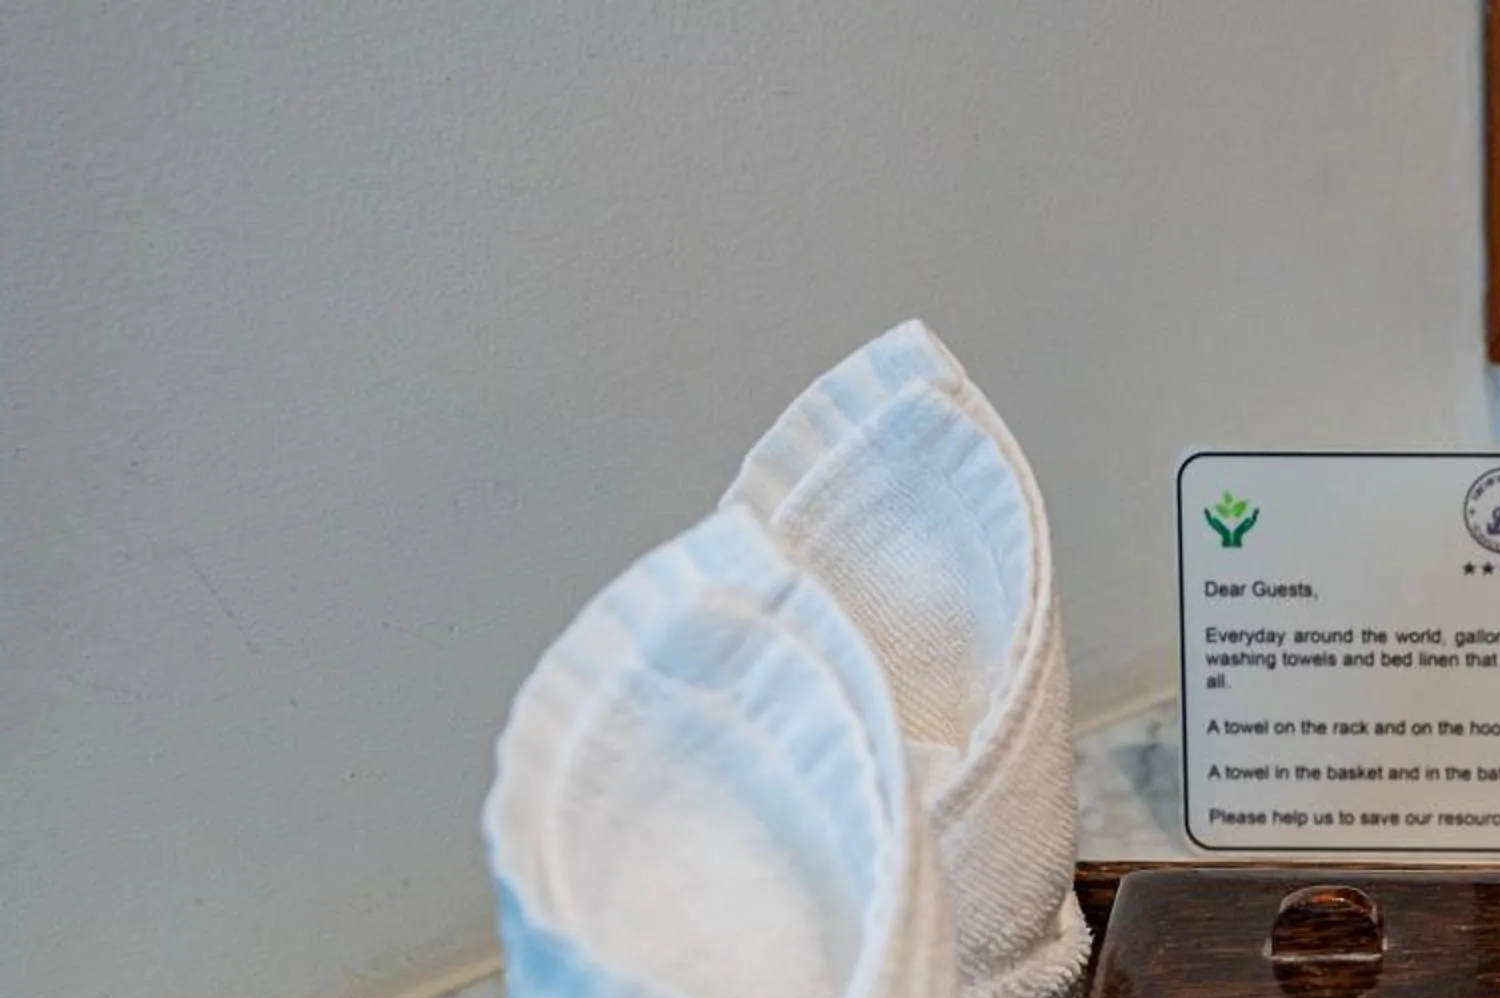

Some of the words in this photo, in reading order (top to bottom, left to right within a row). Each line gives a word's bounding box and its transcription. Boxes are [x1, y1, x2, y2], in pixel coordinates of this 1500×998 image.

[1204, 579, 1247, 599] Dear
[1251, 579, 1320, 602] Guests,
[1205, 626, 1287, 649] Everyday
[1292, 627, 1355, 646] around
[1360, 627, 1389, 646] the
[1394, 627, 1447, 649] world,
[1205, 649, 1277, 672] washing
[1281, 649, 1338, 668] towels
[1342, 649, 1375, 668] and
[1380, 649, 1413, 669] bed
[1418, 650, 1460, 669] linen
[1465, 651, 1498, 669] that
[1205, 672, 1233, 690] all.
[1207, 718, 1220, 736] A
[1224, 719, 1269, 736] towel
[1273, 721, 1296, 736] on
[1300, 719, 1328, 736] the
[1332, 719, 1369, 737] rack
[1374, 719, 1406, 737] and
[1410, 721, 1433, 737] on
[1437, 719, 1464, 737] the
[1206, 763, 1222, 781] A
[1224, 764, 1270, 782] towel
[1274, 764, 1291, 781] in
[1294, 764, 1323, 782] the
[1325, 763, 1384, 782] basket
[1387, 765, 1421, 782] and
[1424, 765, 1441, 782] in
[1444, 765, 1473, 783] the
[1208, 807, 1267, 826] Please
[1272, 809, 1309, 829] help
[1313, 811, 1334, 827] us
[1338, 809, 1356, 827] to
[1360, 811, 1400, 827] save
[1405, 811, 1433, 827] our
